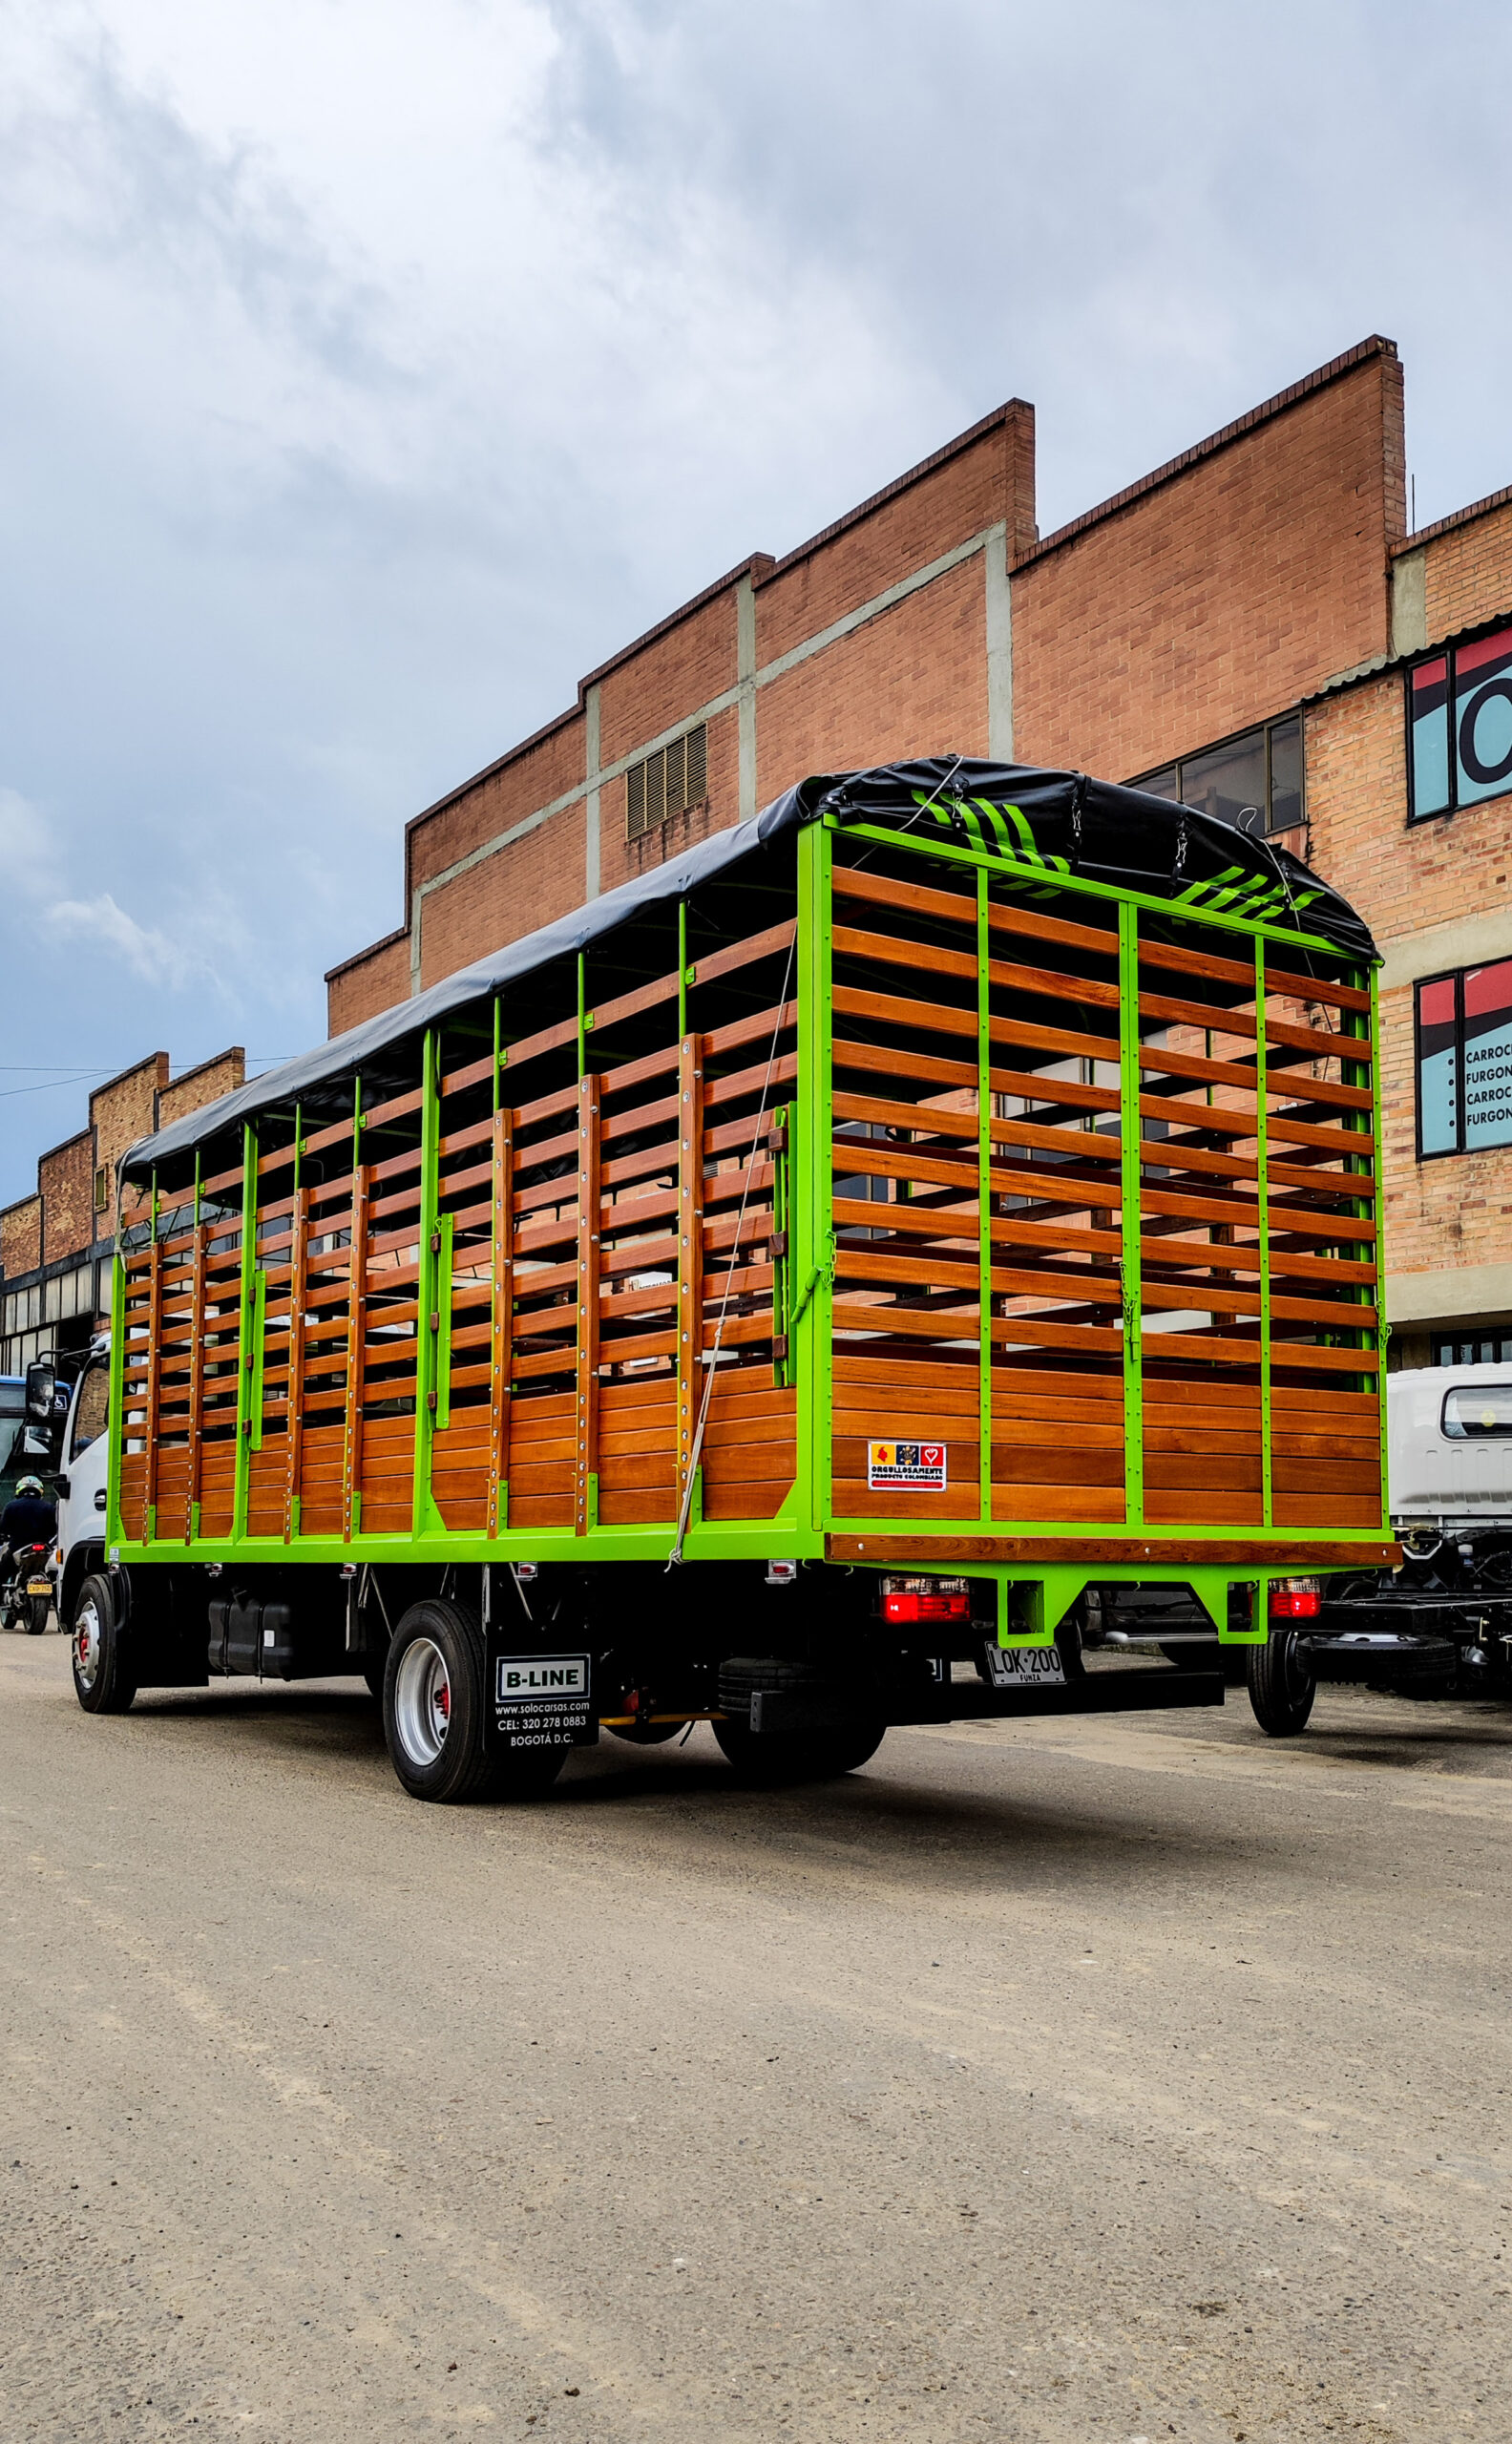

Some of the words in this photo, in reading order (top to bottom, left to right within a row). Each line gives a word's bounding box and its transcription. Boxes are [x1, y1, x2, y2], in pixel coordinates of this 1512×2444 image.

[1466, 1043, 1512, 1064] CARROC
[507, 1669, 578, 1688] B-LINE
[1019, 1674, 1041, 1682] FUNZA
[495, 1702, 590, 1715] www.solocarsas.com
[497, 1720, 519, 1731] CEL:
[522, 1718, 540, 1729] 320
[542, 1717, 560, 1728] 278
[562, 1716, 586, 1726] 0883
[511, 1731, 552, 1746] BOGOTÁ
[554, 1733, 574, 1743] D.C.
